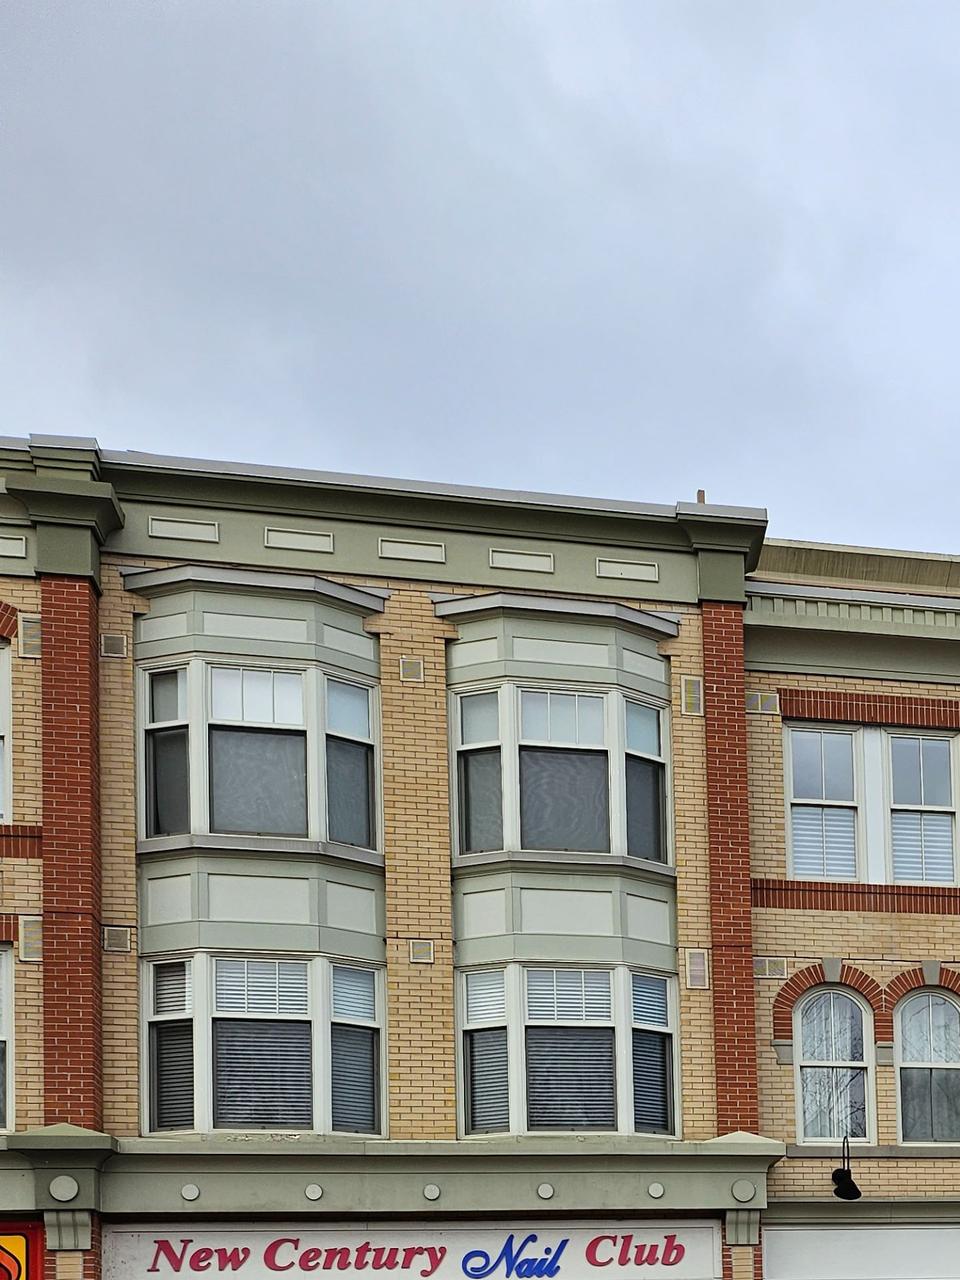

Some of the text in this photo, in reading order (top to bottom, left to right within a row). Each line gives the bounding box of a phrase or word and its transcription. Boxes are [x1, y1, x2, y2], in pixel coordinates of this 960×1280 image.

[147, 1233, 686, 1279] New Century Nail Club
